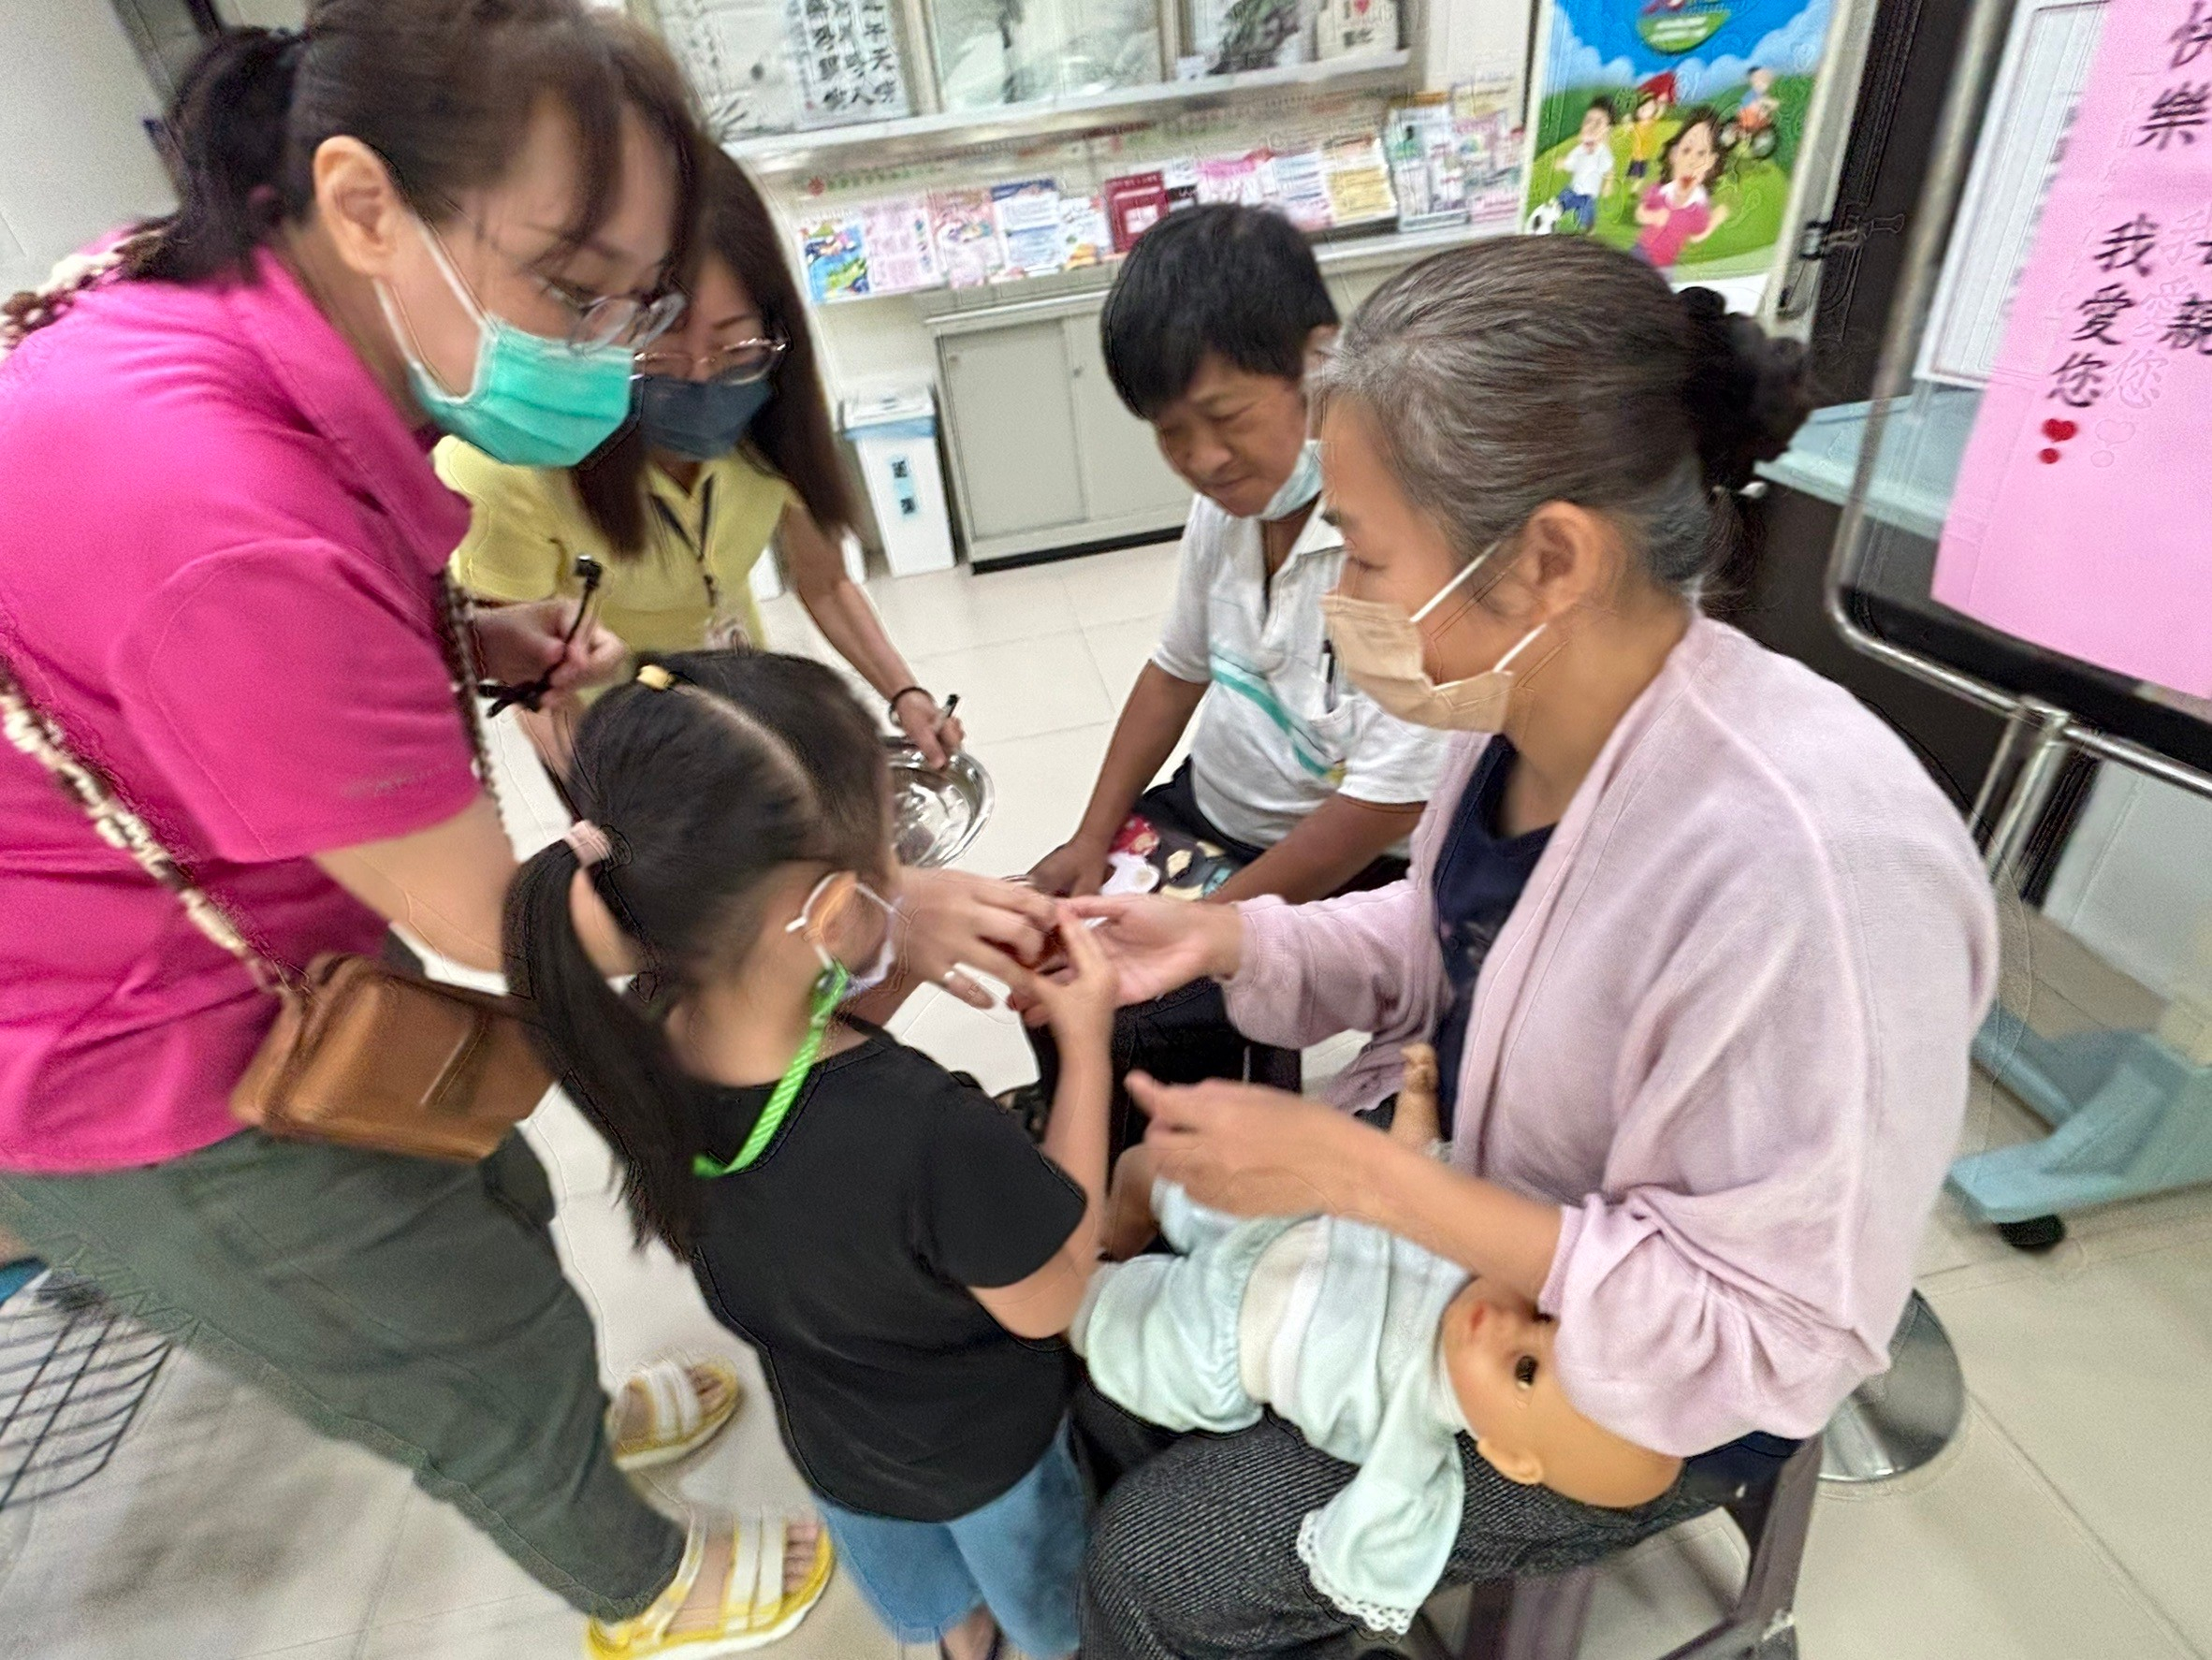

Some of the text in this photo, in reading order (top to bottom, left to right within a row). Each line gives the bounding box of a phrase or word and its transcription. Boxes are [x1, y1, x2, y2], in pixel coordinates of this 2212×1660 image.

[2046, 213, 2159, 408] 我愛您
[2158, 241, 2212, 356] 親
